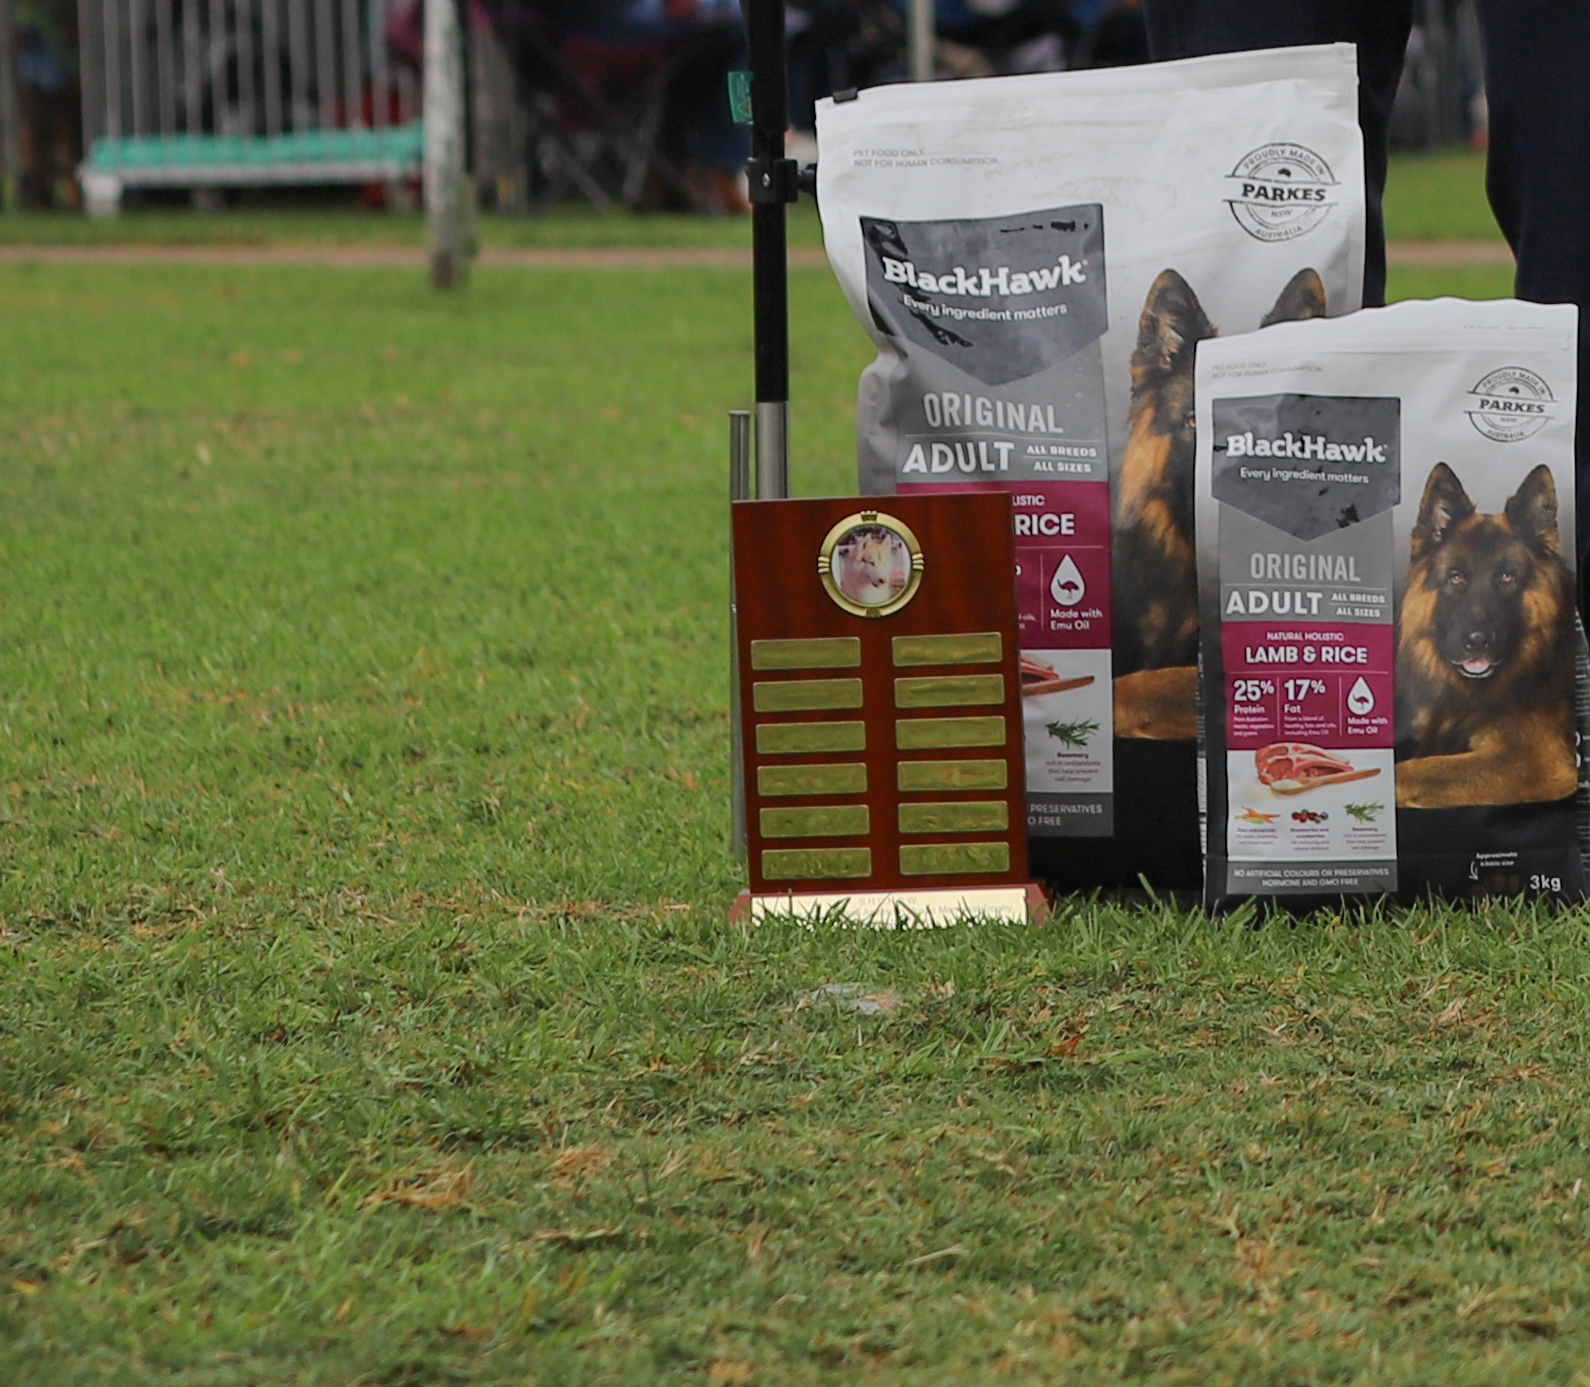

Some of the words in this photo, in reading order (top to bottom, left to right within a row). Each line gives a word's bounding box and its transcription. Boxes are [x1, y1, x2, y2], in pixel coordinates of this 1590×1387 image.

[1243, 149, 1286, 170] PROUDLY
[1289, 149, 1316, 166] MADE
[1241, 183, 1326, 201] PARKES
[1271, 209, 1292, 218] NSW
[1255, 226, 1303, 239] AUSTRALIA
[903, 294, 940, 316] Every
[941, 304, 1011, 321] ingredient
[1014, 302, 1067, 321] matters
[1479, 398, 1545, 413] PARKES
[923, 391, 1064, 434] ORIGINAL
[903, 441, 1015, 473] ADULT
[1026, 445, 1048, 455] ALL
[1050, 445, 1097, 457] BREEDS
[1033, 461, 1054, 471] ALL
[1057, 462, 1092, 473] SIZES
[1240, 467, 1271, 482] Every
[1272, 468, 1327, 482] ingredient
[1328, 472, 1369, 484] matters
[1012, 495, 1045, 507] LISTIC
[1014, 513, 1075, 536] RICE
[1250, 552, 1361, 582] ORIGINAL
[1226, 590, 1323, 615] ADULT
[1331, 593, 1348, 602] ALL
[1349, 593, 1386, 604] BREEDS
[1050, 608, 1079, 619] Made
[1081, 608, 1103, 618] with
[1336, 607, 1353, 616] ALL
[1354, 608, 1381, 618] SIZES
[1050, 621, 1073, 631] Emu
[1074, 620, 1090, 631] Oil
[1266, 632, 1303, 641] NATURAL
[1304, 632, 1344, 641] HOLISTIC
[1246, 646, 1298, 664] LAMB
[1303, 647, 1317, 663] &
[1321, 647, 1368, 664] RICE
[1233, 679, 1275, 702] 25%
[1284, 679, 1326, 702] 17%
[1233, 704, 1265, 714] Protein
[1284, 704, 1301, 714] Fat
[1348, 717, 1371, 725] Made
[1372, 717, 1388, 725] with
[1366, 727, 1378, 735] Oil
[1030, 803, 1103, 814] PRESERVATIVES
[1039, 817, 1062, 827] FREE
[1234, 869, 1245, 877] NO
[1283, 869, 1319, 877] COLOURS
[1321, 869, 1332, 877] OR
[1334, 868, 1389, 876] PRESERVATIVES
[1262, 879, 1300, 887] HORMONE
[1302, 879, 1317, 887] AND
[1340, 878, 1358, 886] FREE
[1530, 874, 1562, 892] 3kg
